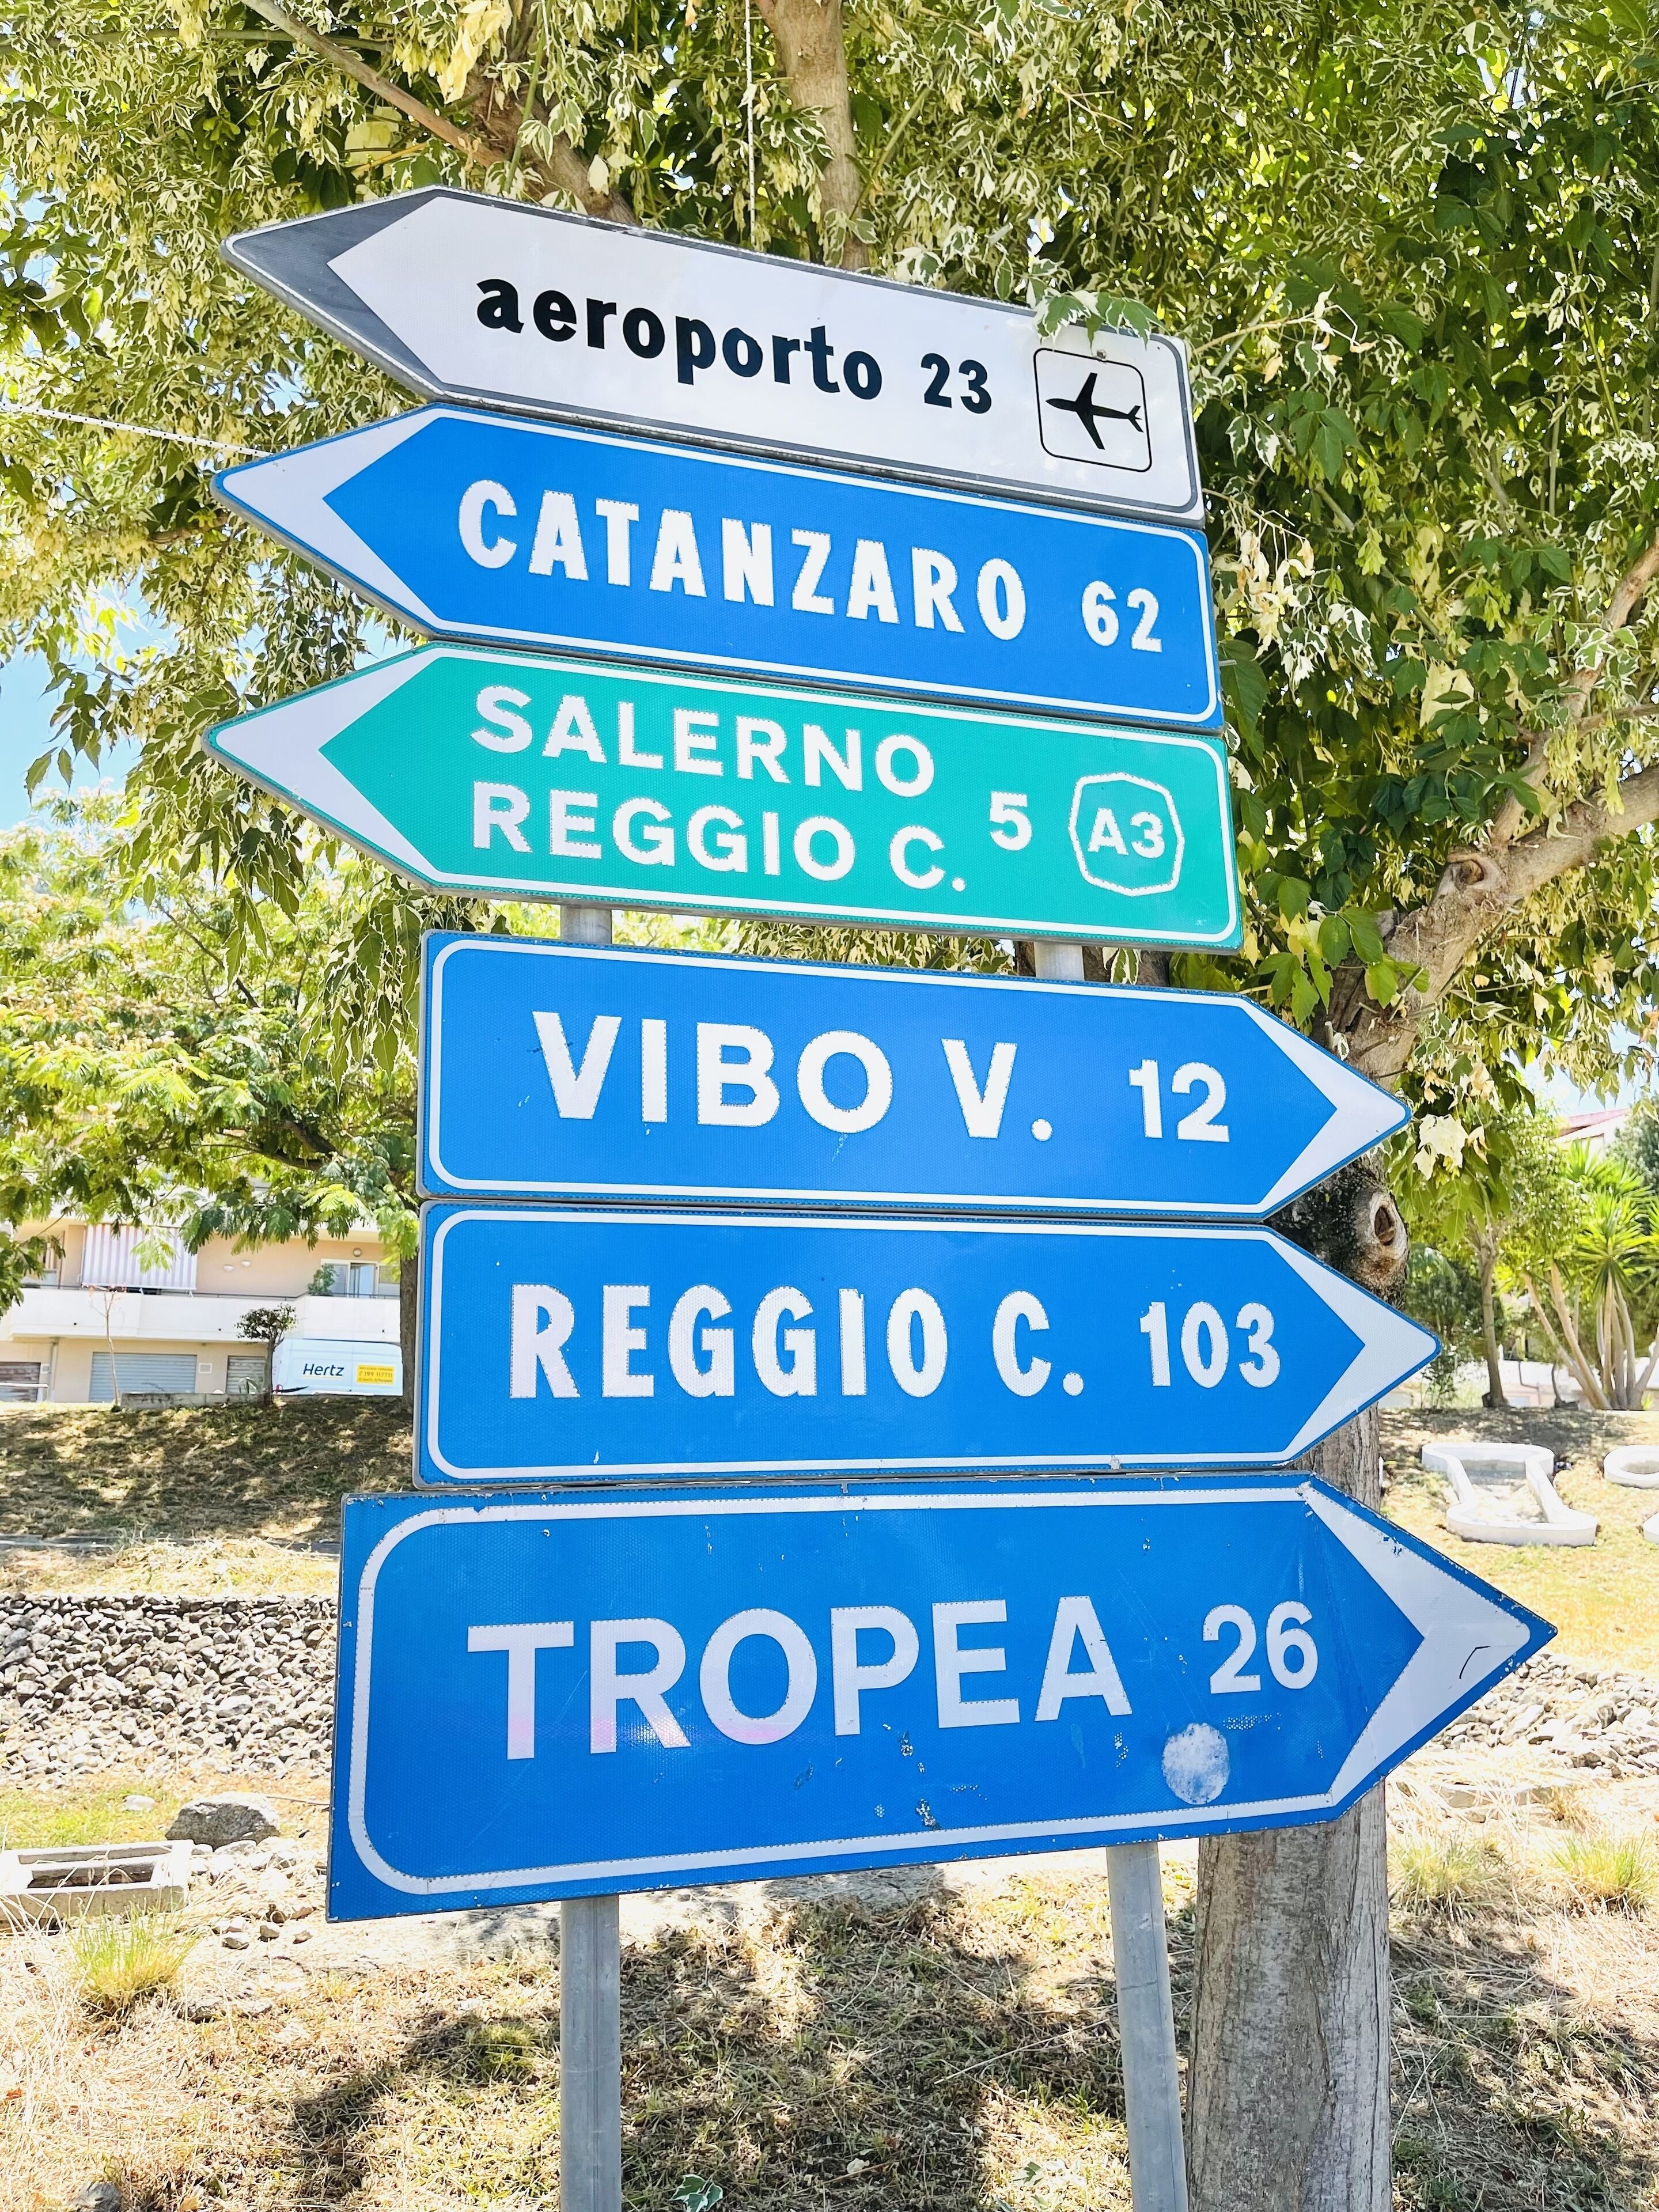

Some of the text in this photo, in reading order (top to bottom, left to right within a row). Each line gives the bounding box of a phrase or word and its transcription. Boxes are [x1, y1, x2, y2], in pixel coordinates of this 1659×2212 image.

[476, 279, 991, 414] aeroporto 23
[459, 479, 1161, 652] CATANZARO 62
[471, 685, 935, 797] SALERNO
[472, 781, 1032, 892] REGGIO C. 5
[1088, 808, 1165, 858] A3
[532, 1012, 1229, 1142] VIBO V. 12
[303, 1363, 345, 1377] Hertz
[510, 1284, 1280, 1399] REGGIO C. 103
[467, 1596, 1318, 1760] TROPEA 26
